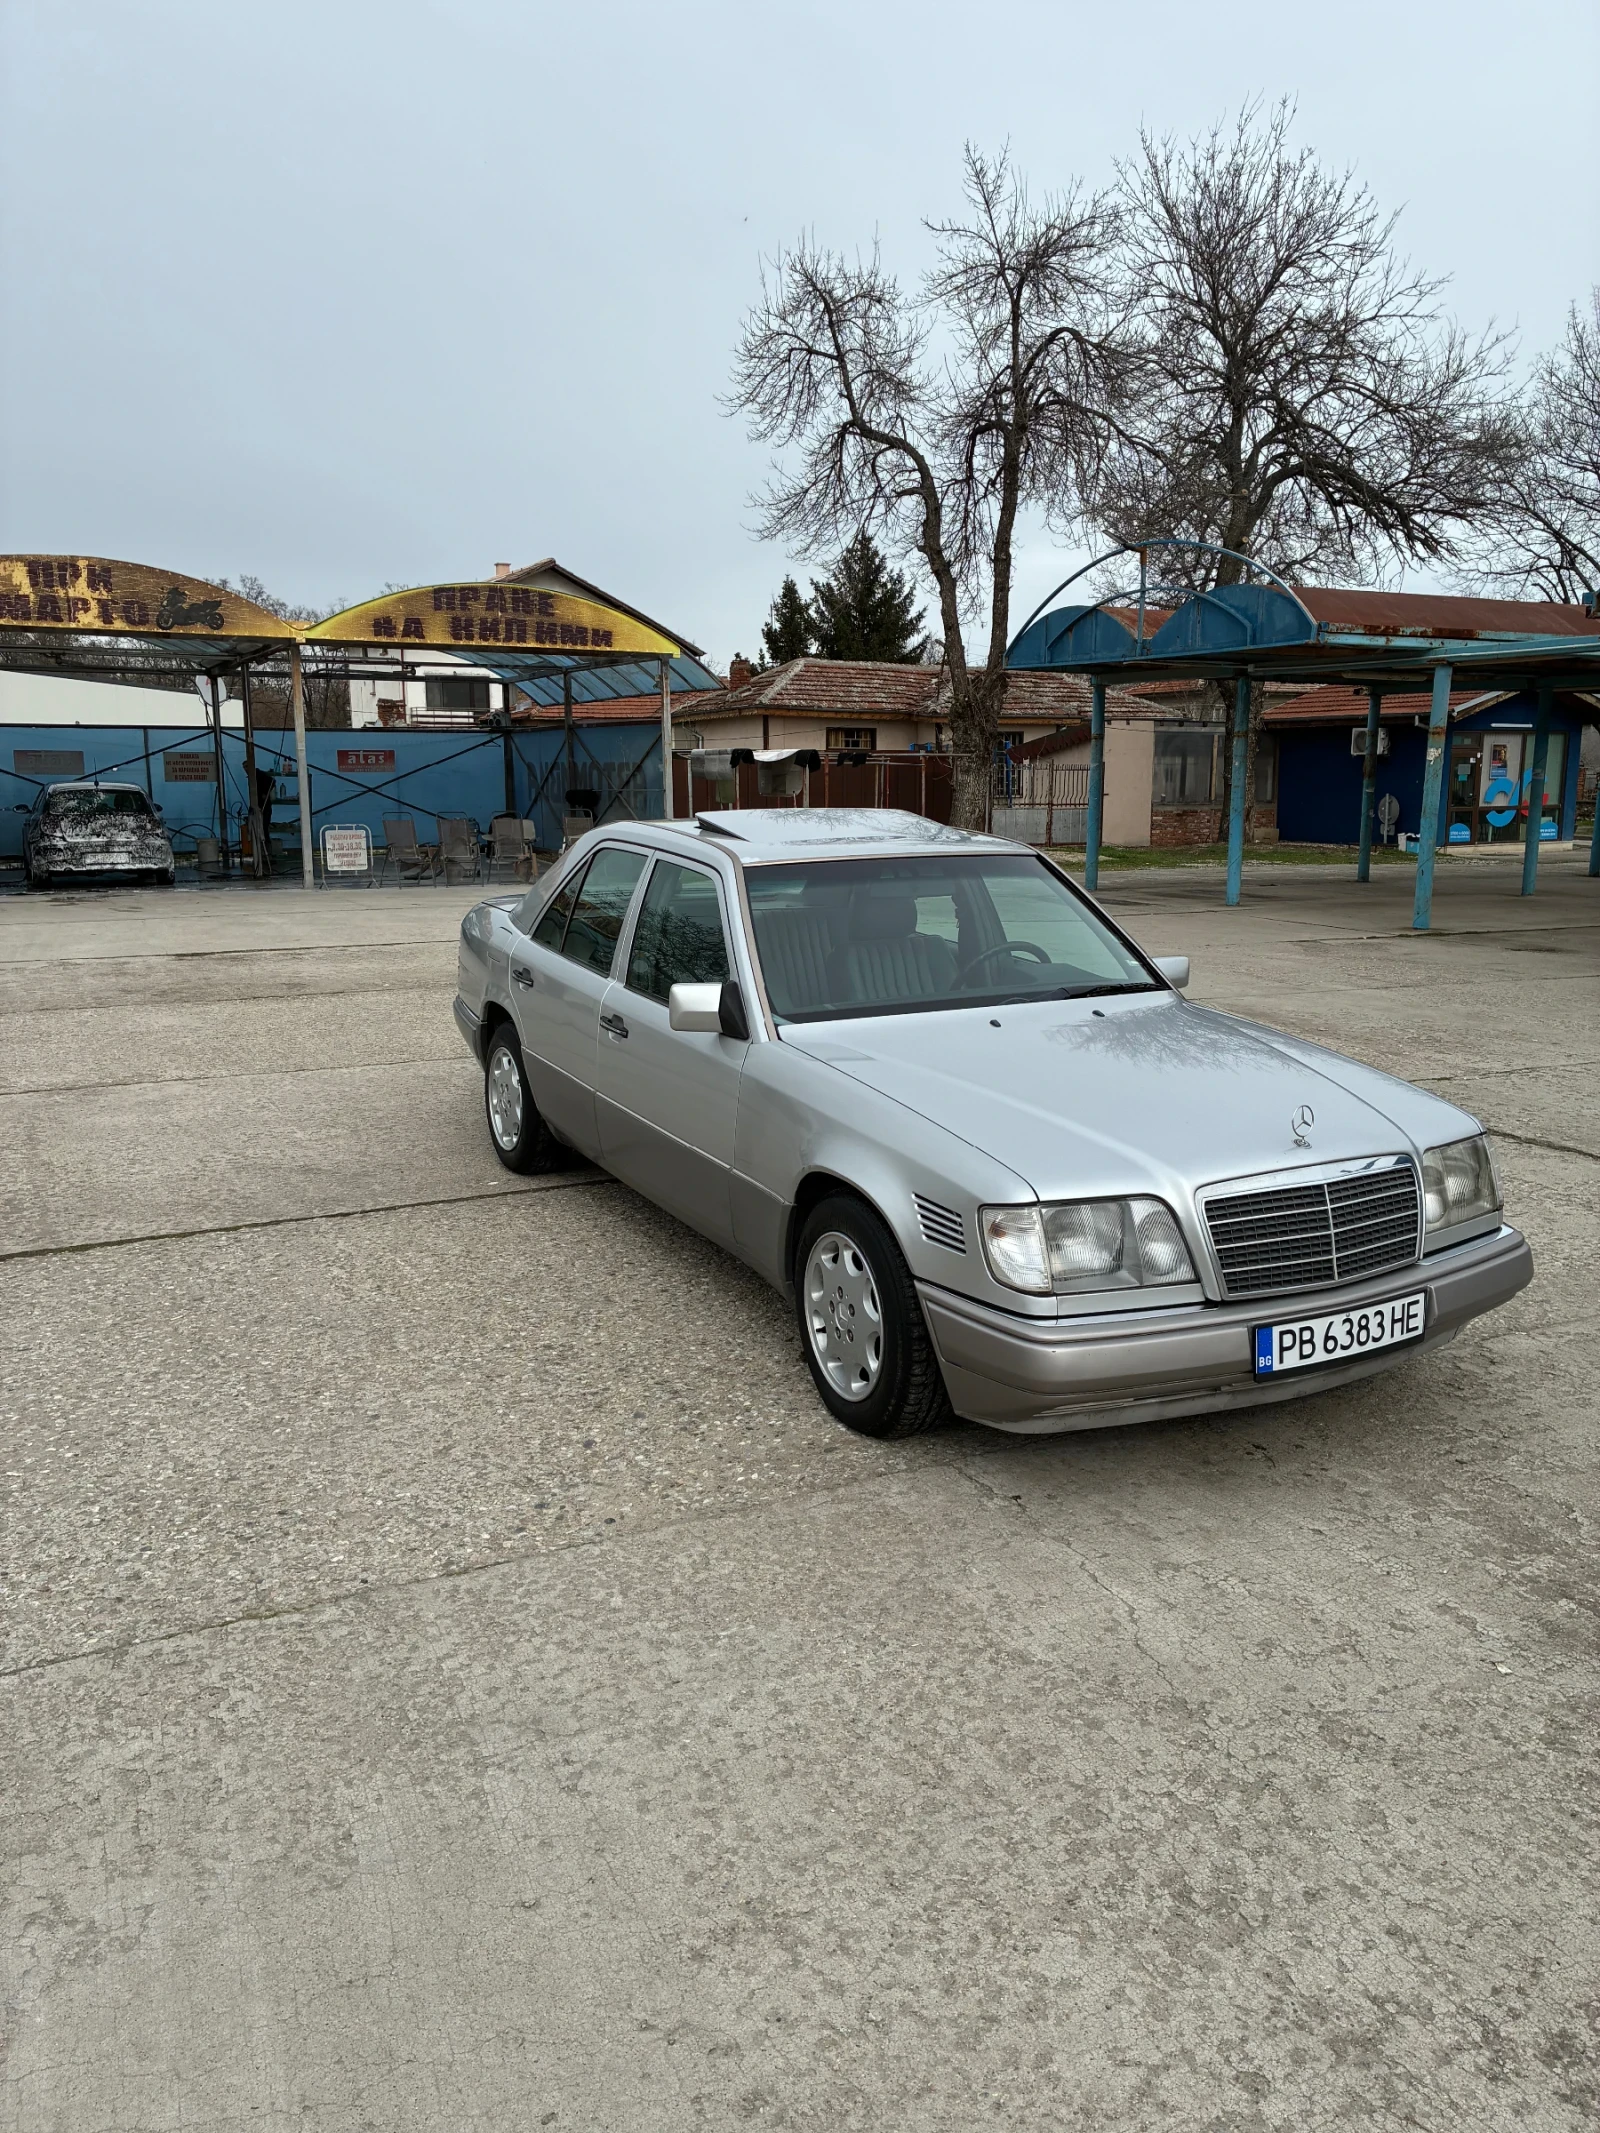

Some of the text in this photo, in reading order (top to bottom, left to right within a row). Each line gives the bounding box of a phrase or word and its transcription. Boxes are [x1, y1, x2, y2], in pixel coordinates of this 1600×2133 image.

[433, 586, 555, 617] ПРАНЕ
[373, 615, 614, 648] НА КИЛИМИ
[348, 750, 385, 764] atas
[1278, 1299, 1421, 1365] PB 6383 HE
[1258, 1356, 1273, 1368] BG
